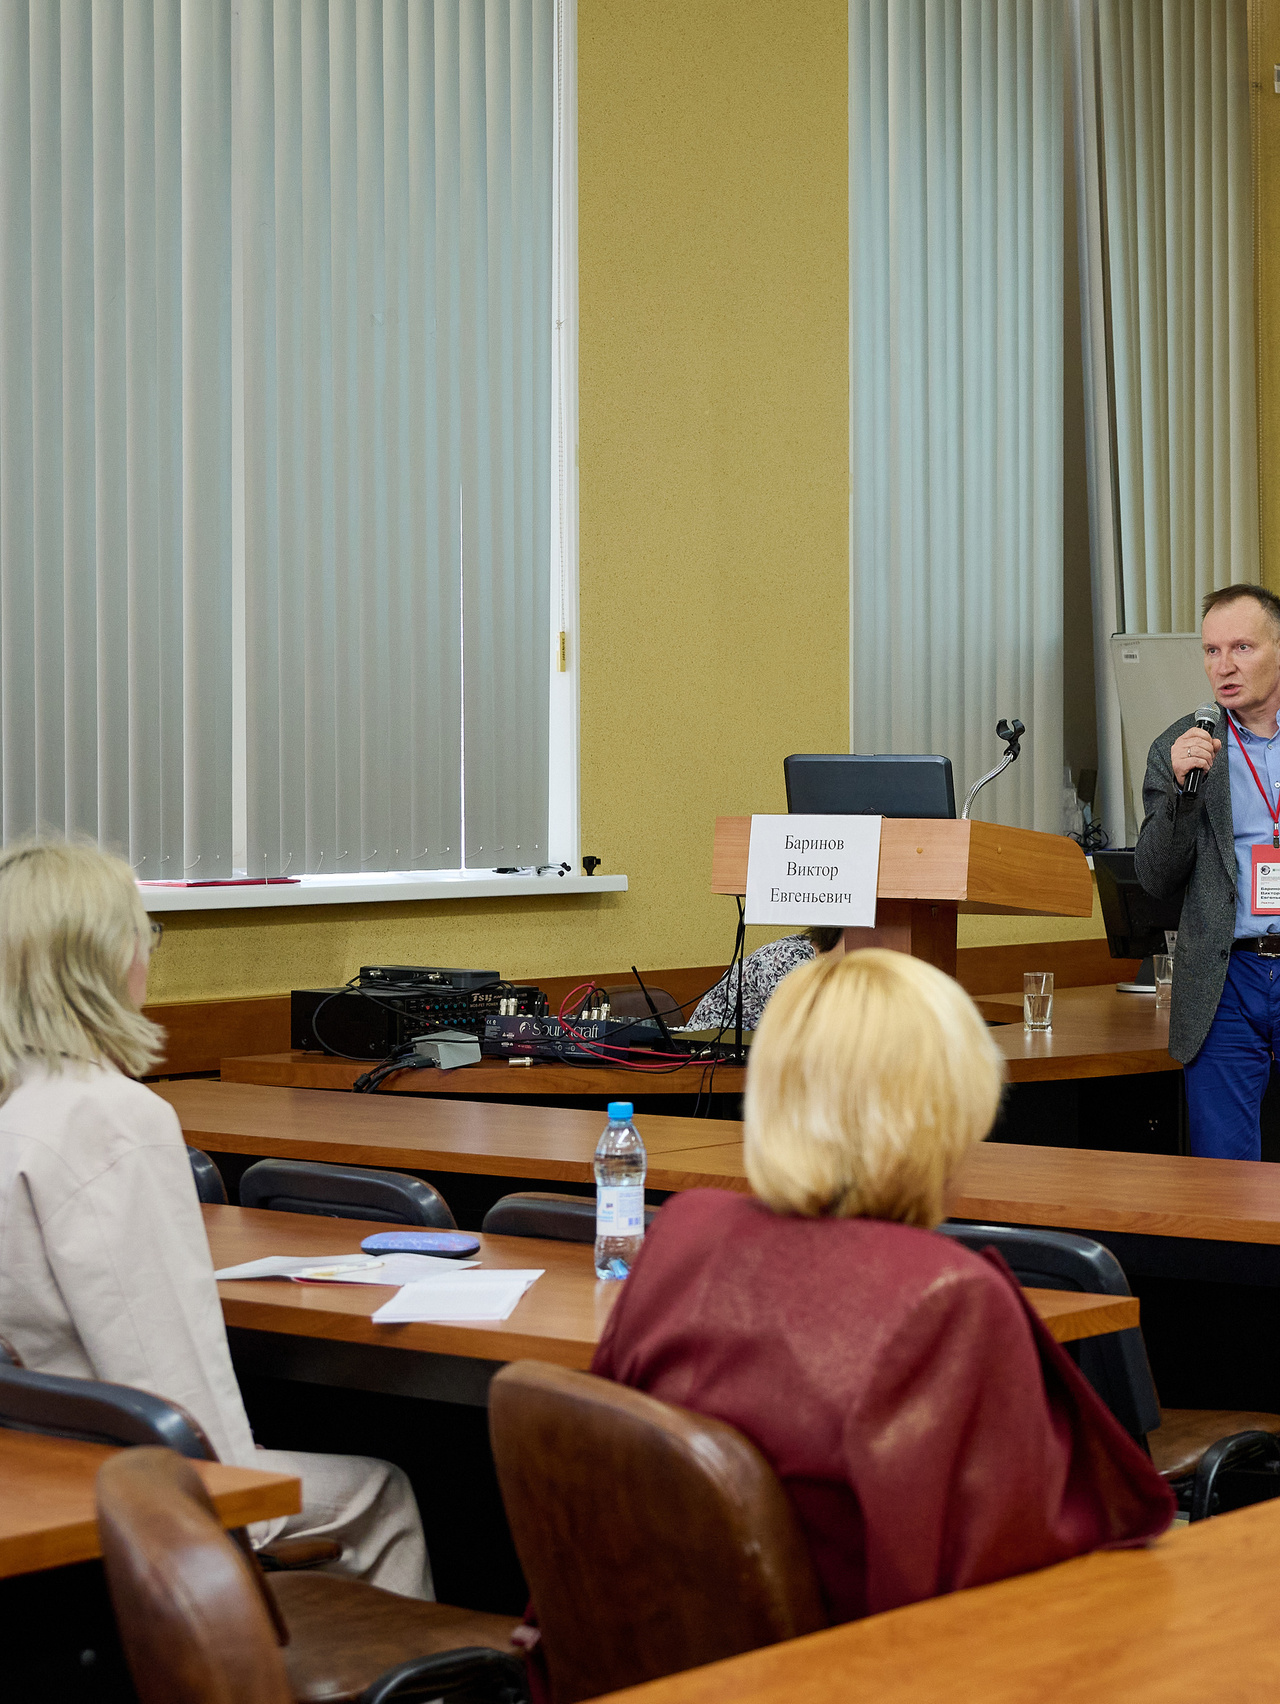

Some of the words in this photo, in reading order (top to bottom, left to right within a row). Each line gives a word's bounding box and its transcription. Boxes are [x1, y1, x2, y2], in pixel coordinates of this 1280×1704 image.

[785, 835, 845, 853] Баринов
[786, 861, 839, 880] Виктор
[770, 887, 852, 903] Евгеньевич
